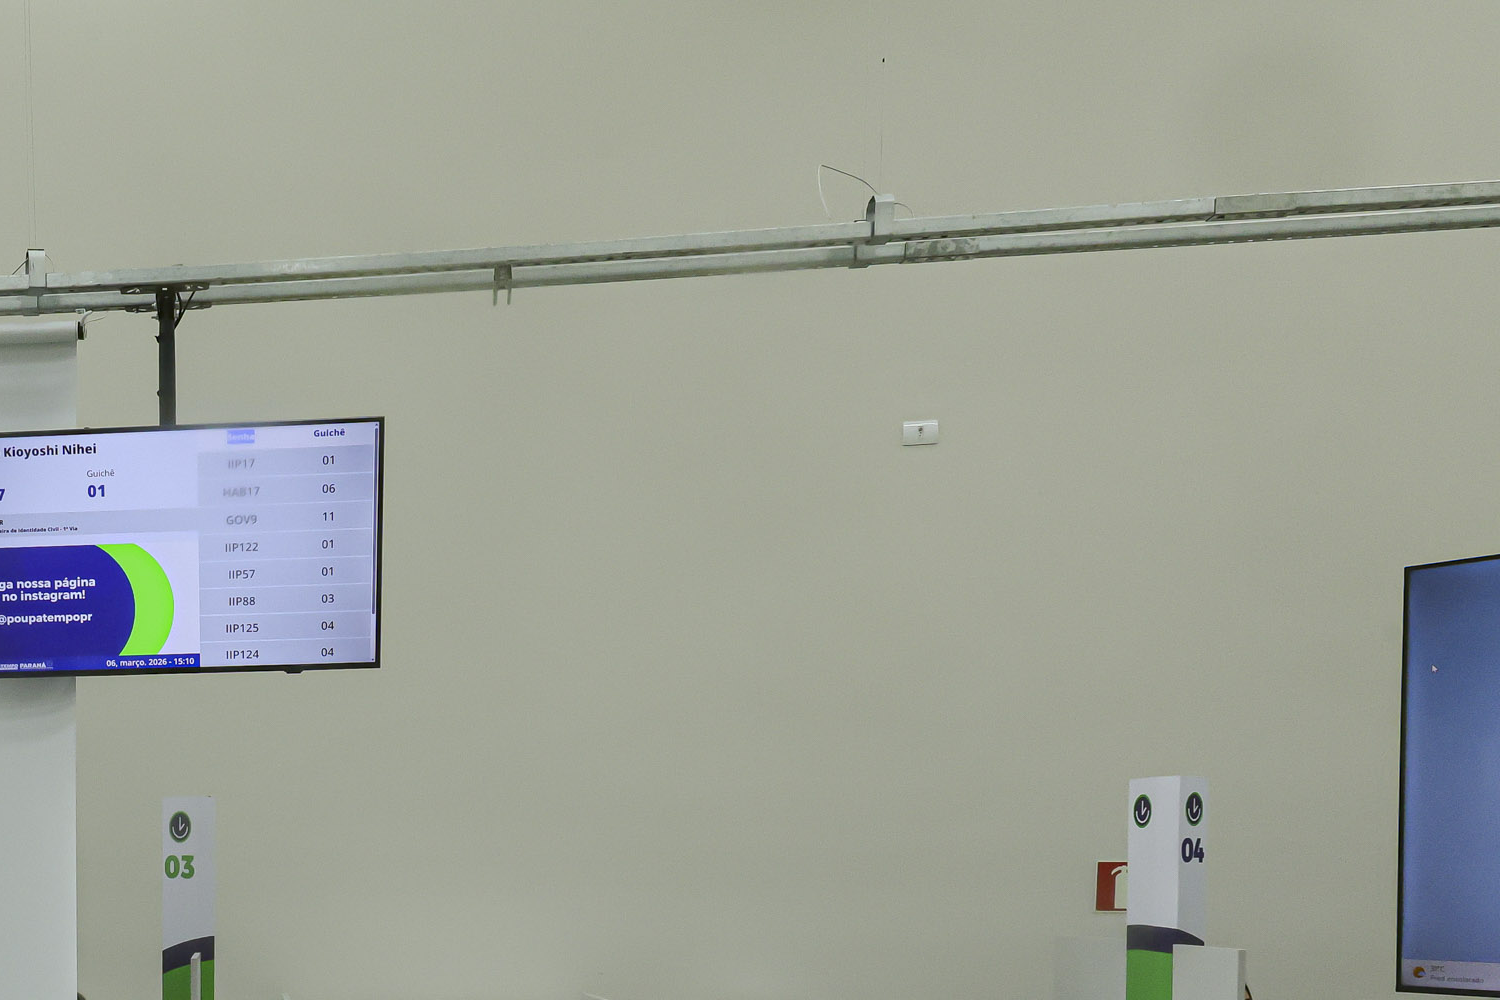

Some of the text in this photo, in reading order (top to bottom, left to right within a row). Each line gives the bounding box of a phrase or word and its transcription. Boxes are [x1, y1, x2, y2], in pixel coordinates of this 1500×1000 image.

[313, 428, 345, 437] Guichê
[4, 445, 58, 460] Kioyoshi
[62, 443, 97, 456] Nihei
[228, 458, 255, 469] IIP17
[322, 455, 335, 465] 01
[86, 469, 115, 478] Guichê
[87, 484, 106, 498] 01
[322, 483, 336, 494] 06
[226, 515, 258, 525] GOV9
[322, 511, 334, 522] 11
[225, 542, 259, 552] IIP122
[321, 539, 334, 549] 01
[228, 570, 255, 579] IIP57
[321, 567, 334, 577] 01
[16, 579, 51, 589] nossa
[54, 577, 96, 591] página
[2, 590, 86, 602] no instagram!
[321, 594, 335, 603] 03
[228, 597, 256, 606] IIP88
[226, 624, 259, 633] IIP125
[321, 621, 335, 630] 04
[226, 650, 259, 660] IIP124
[321, 648, 334, 657] 04
[106, 660, 118, 668] 06,
[120, 660, 147, 668] março.
[148, 658, 167, 666] 2026
[173, 657, 195, 665] 15:10
[1181, 837, 1205, 863] 04
[164, 855, 195, 879] 03
